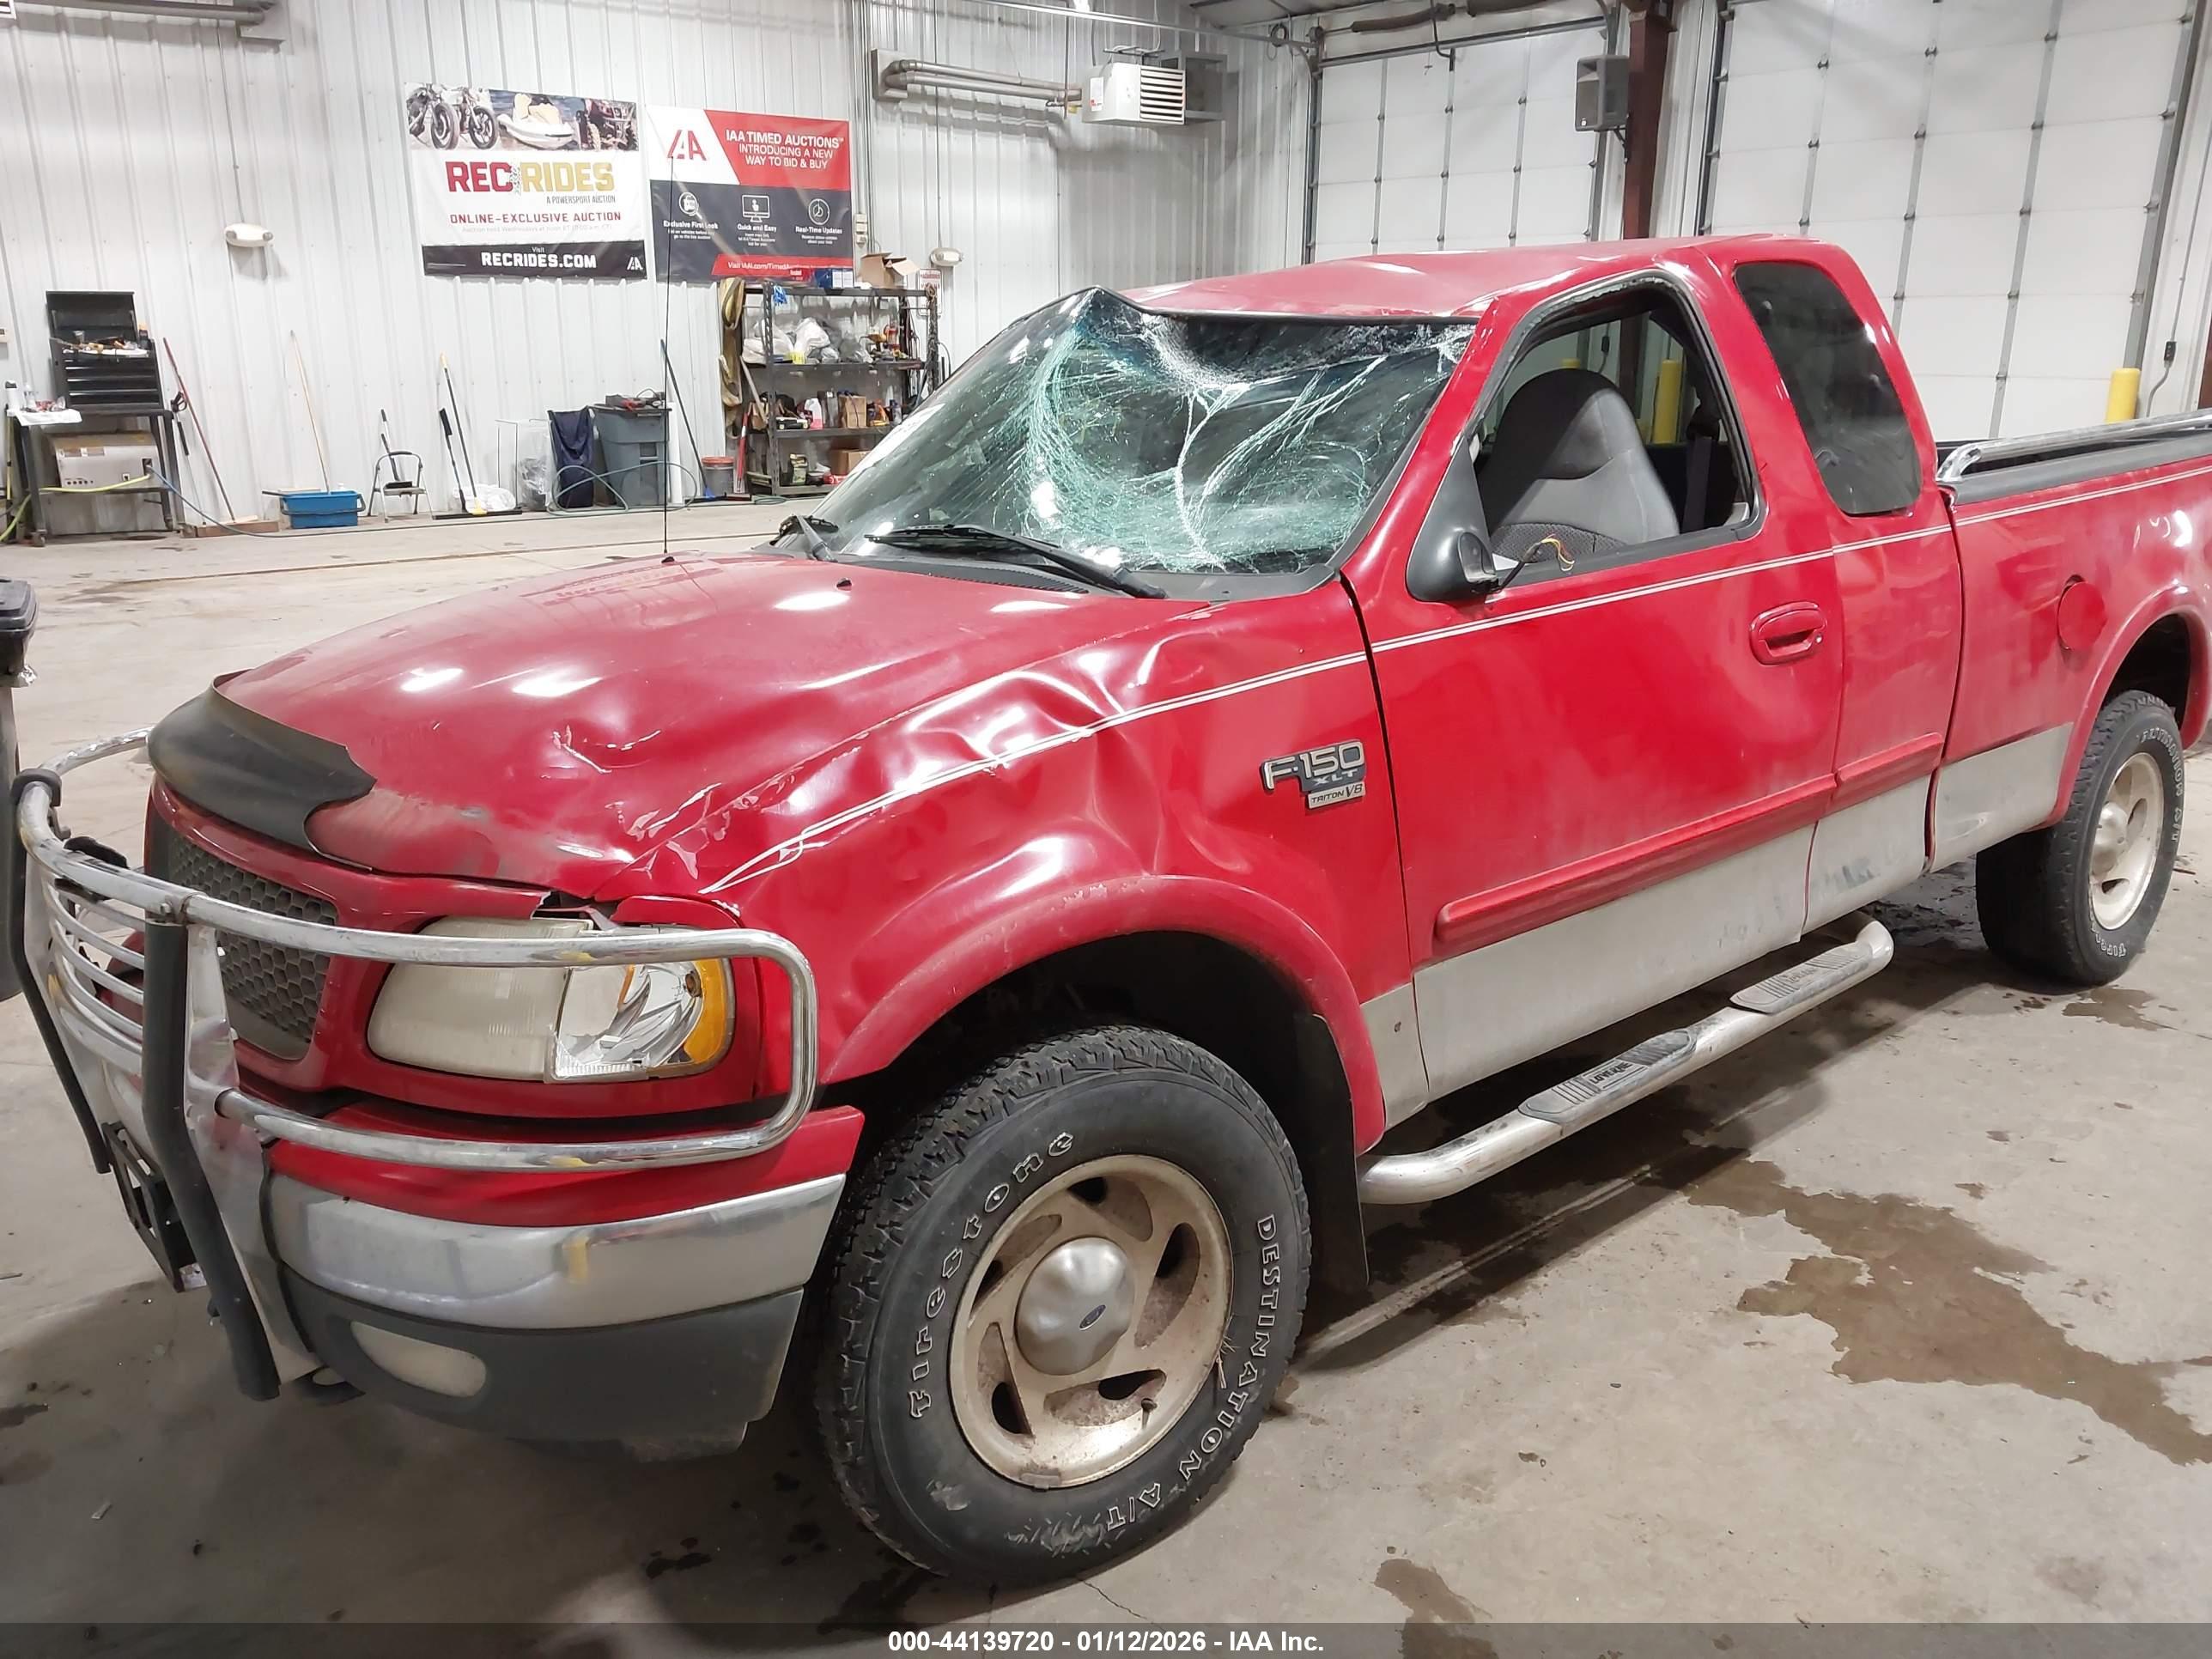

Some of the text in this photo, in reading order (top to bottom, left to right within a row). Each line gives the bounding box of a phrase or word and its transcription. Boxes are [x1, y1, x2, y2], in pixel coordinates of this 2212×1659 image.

[726, 129, 745, 143] IAA
[746, 131, 782, 145] TIMED
[738, 143, 834, 159] INTRODUCING A NEW
[745, 155, 829, 169] WAY TO BID & BUY
[445, 161, 616, 193] REC RIDES
[592, 194, 616, 204] AUCTION
[450, 212, 622, 224] ONLINE-EXCLUSIVE AUCTION
[663, 220, 690, 228] Exclusive
[763, 224, 777, 233] Easy
[481, 252, 597, 268] RECRIDES.COM
[1312, 769, 1358, 787] XLT
[1311, 783, 1363, 804] TRITON V8
[1178, 1213, 1281, 1481] DESTINATION
